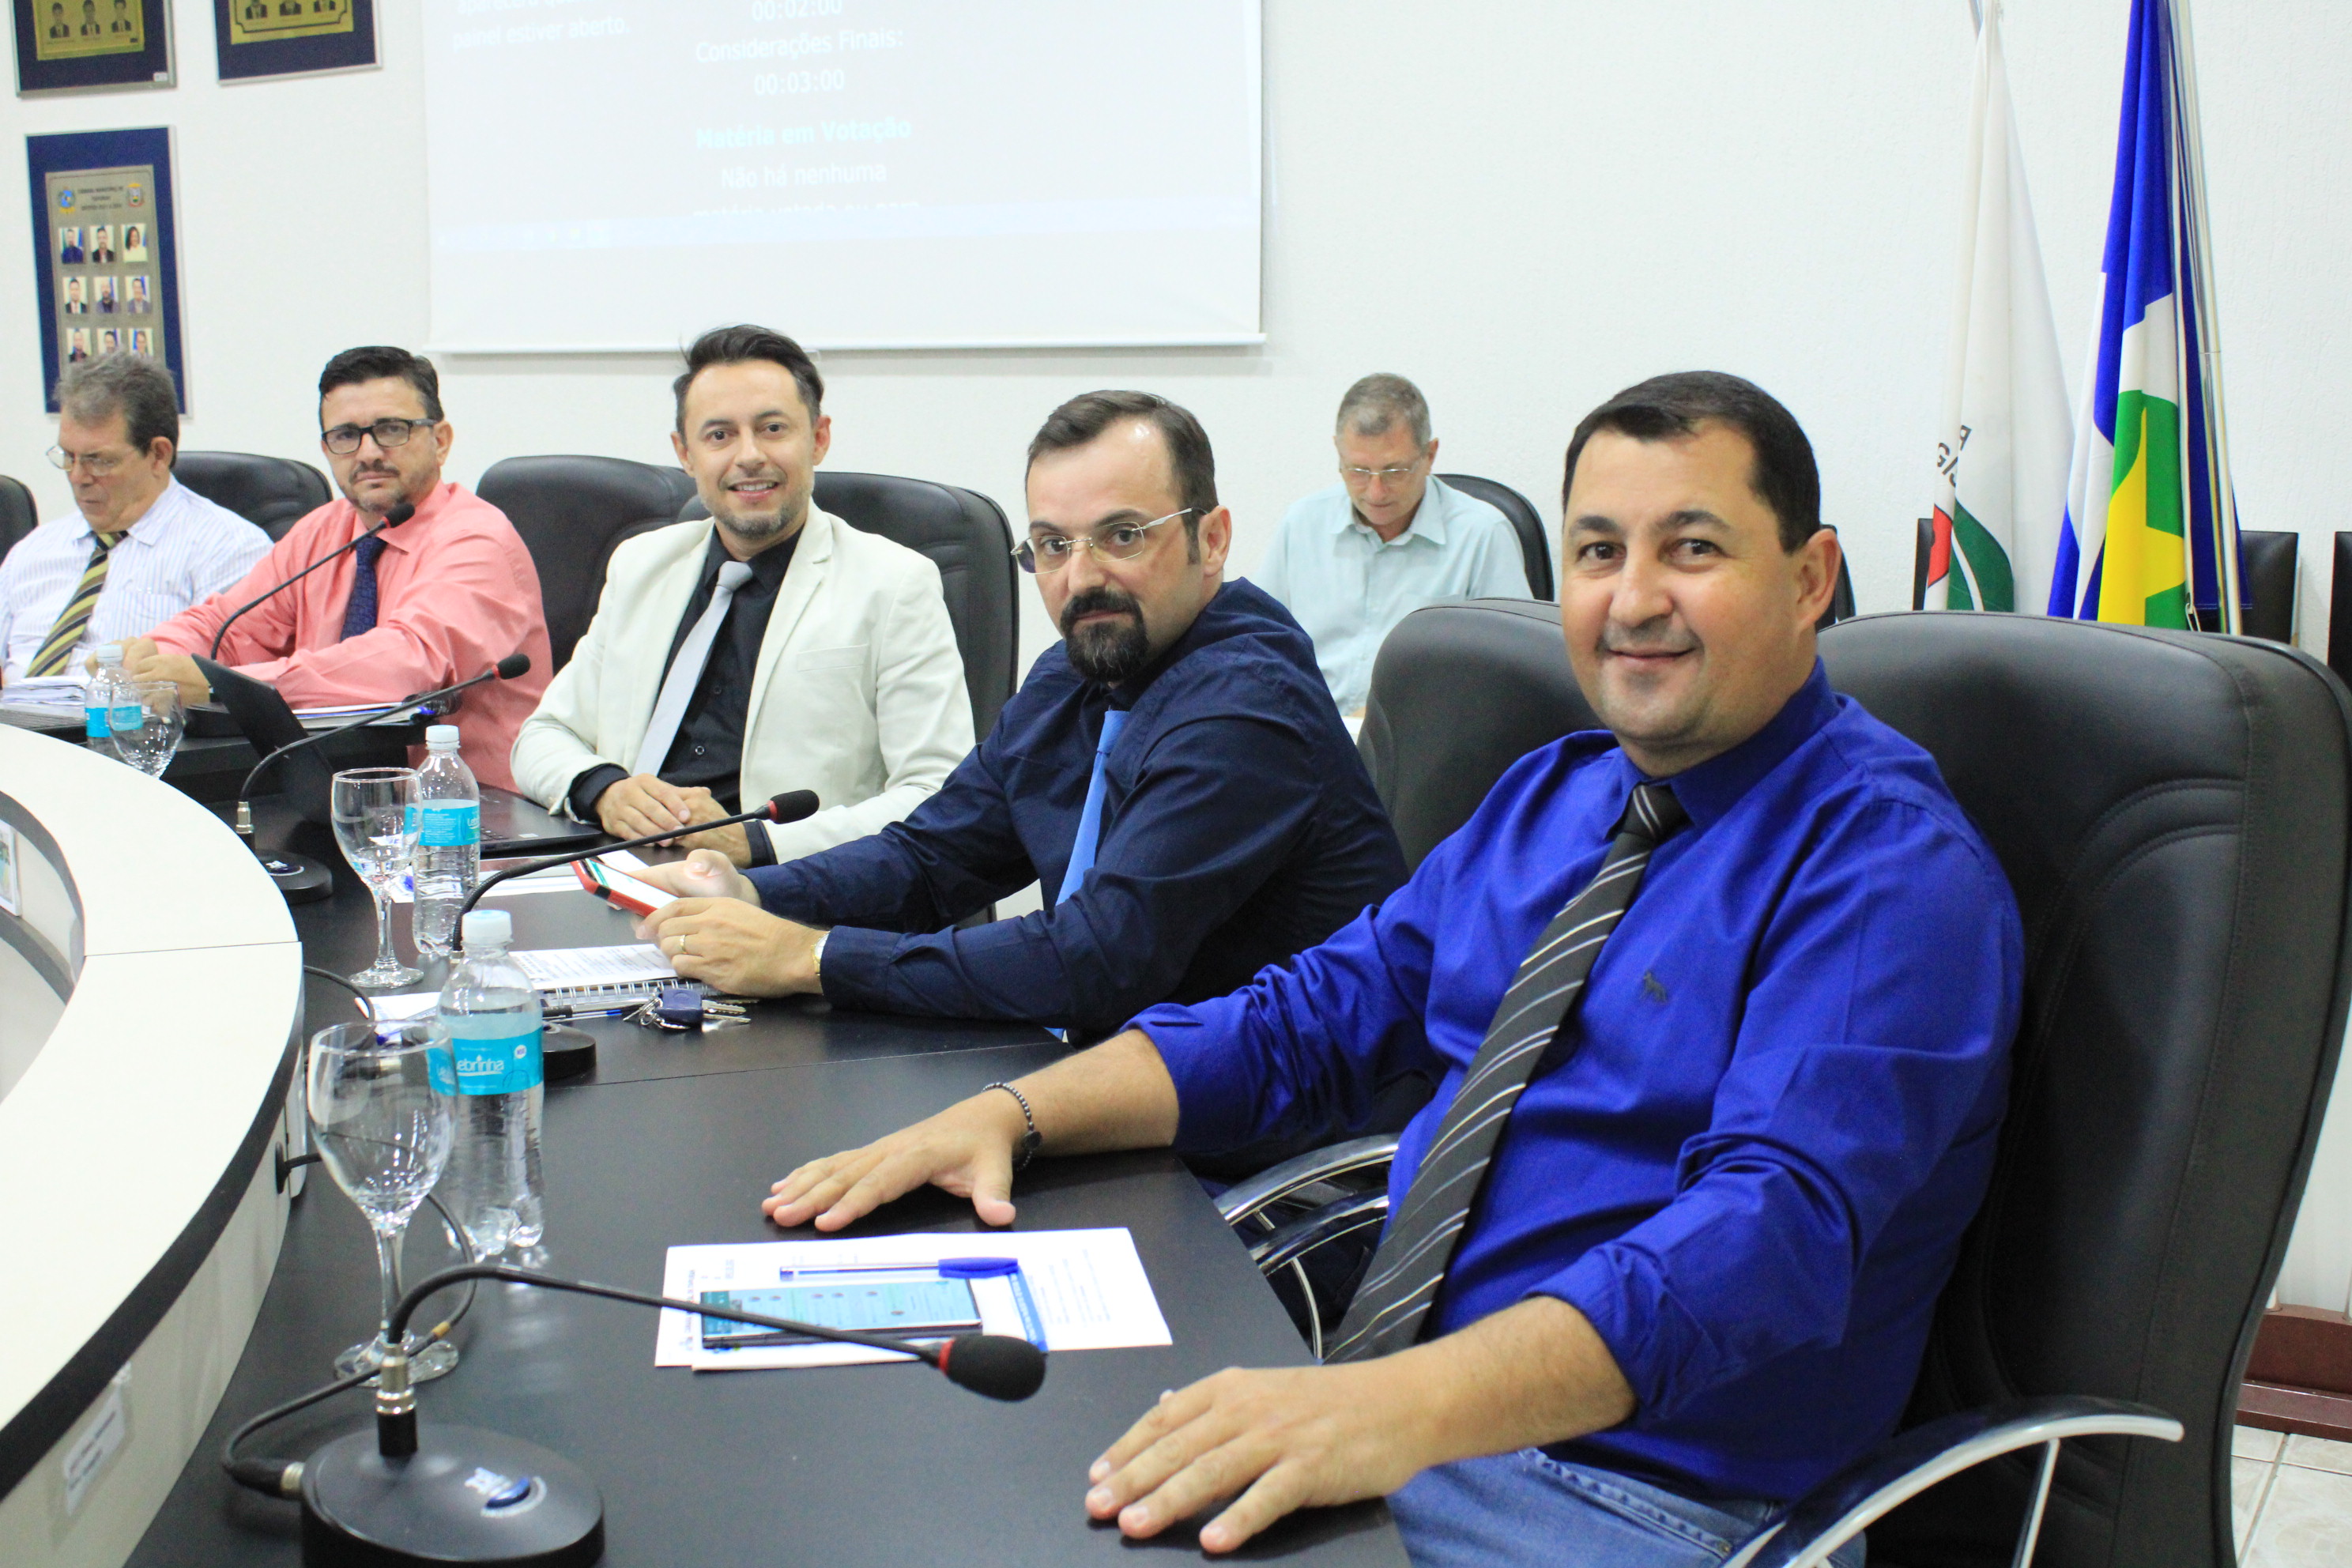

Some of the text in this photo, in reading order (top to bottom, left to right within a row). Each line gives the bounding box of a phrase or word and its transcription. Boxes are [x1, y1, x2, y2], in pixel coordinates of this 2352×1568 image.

[452, 15, 631, 52] painel estiver aberto.
[695, 27, 904, 62] Considerações Finais:
[753, 69, 845, 96] 00:03:00
[695, 116, 913, 149] Matéria em Votação
[721, 163, 888, 190] Não há nenhuma
